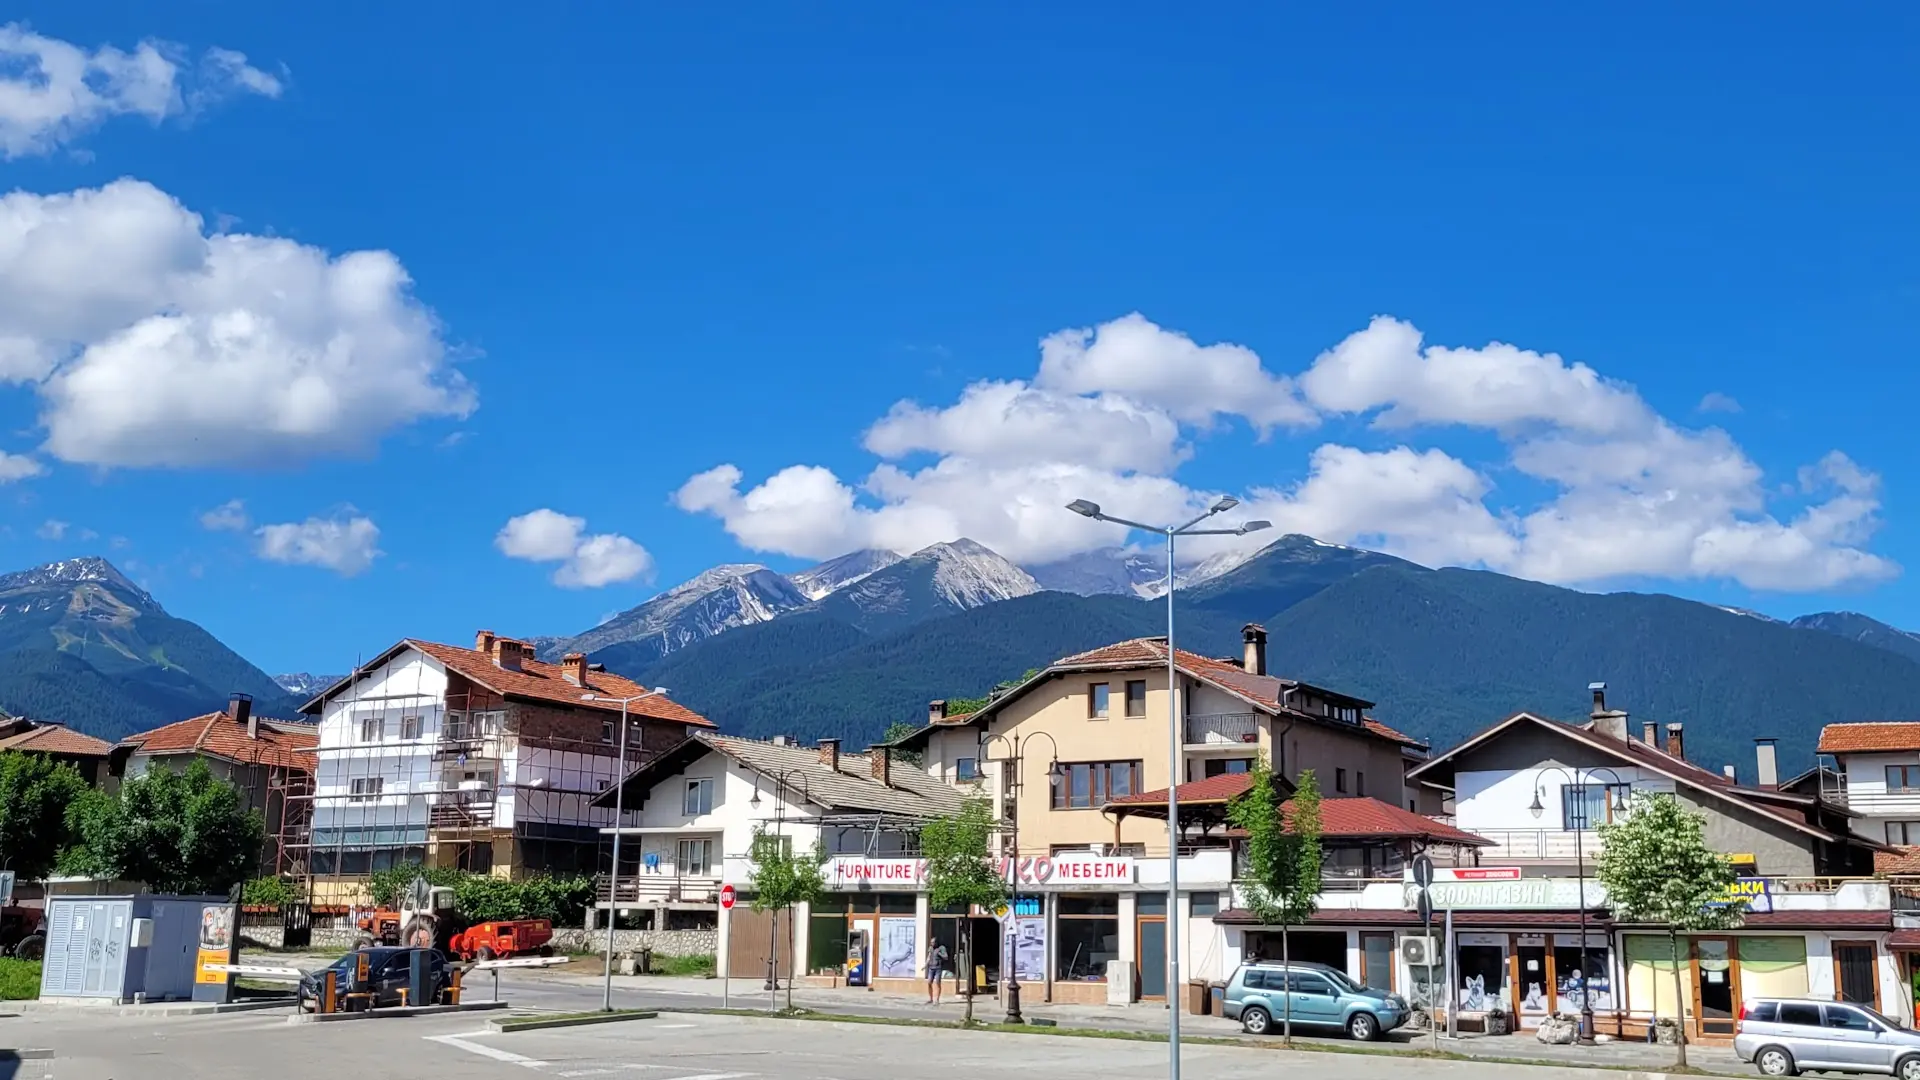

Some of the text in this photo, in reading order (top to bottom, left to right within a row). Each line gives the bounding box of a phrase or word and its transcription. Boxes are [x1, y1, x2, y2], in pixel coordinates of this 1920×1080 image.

[838, 865, 911, 878] FURNITURE
[1059, 863, 1127, 877] МЕБЕЛИ
[722, 891, 735, 902] STOP
[1436, 883, 1546, 905] ЗООМАГАЗИН
